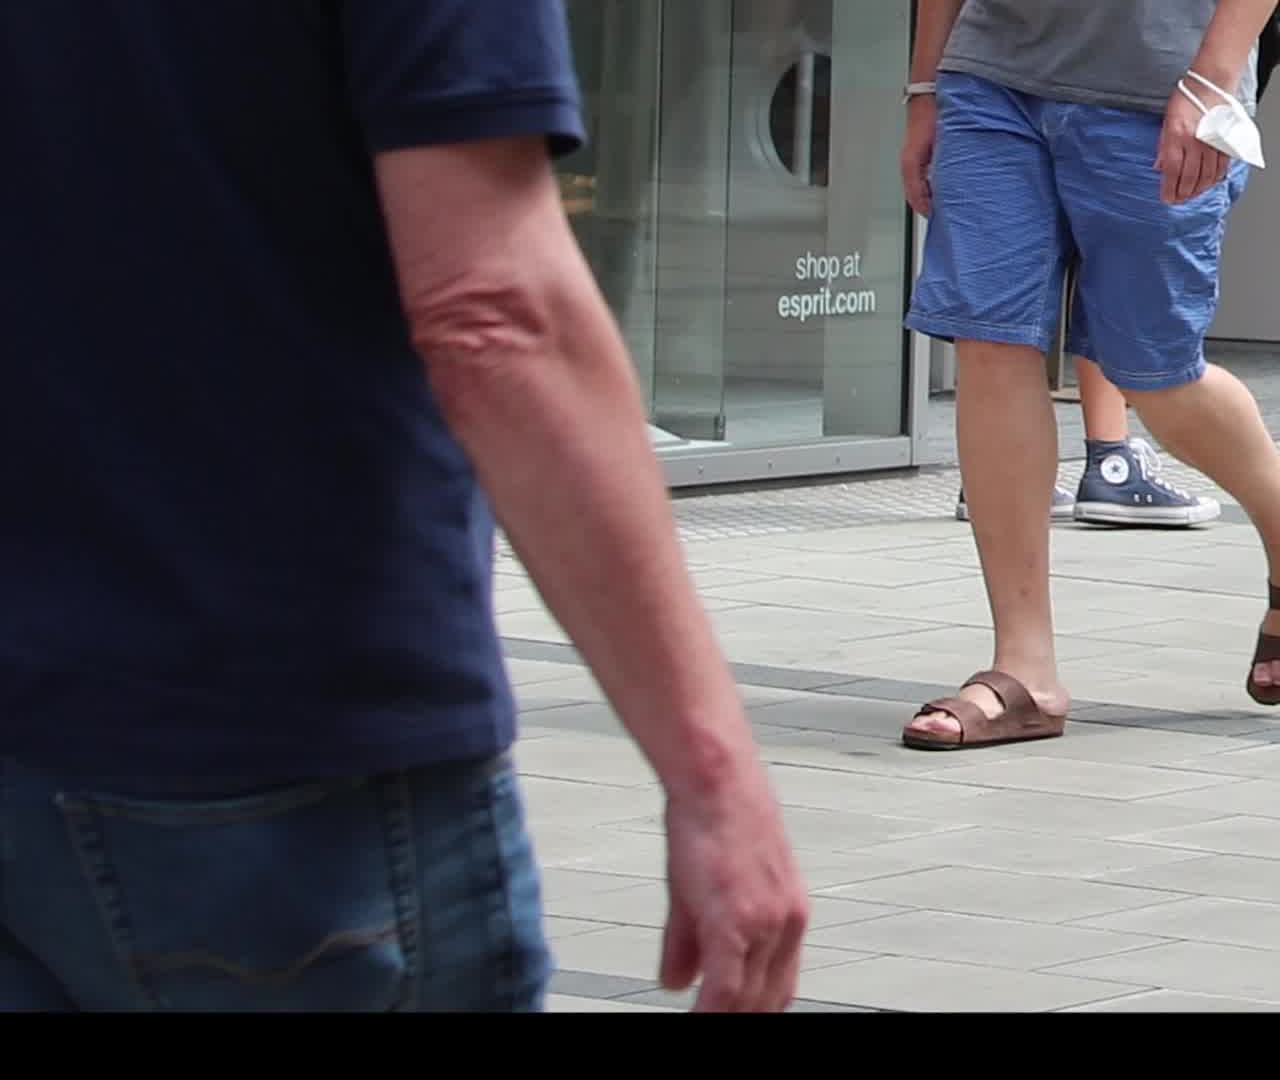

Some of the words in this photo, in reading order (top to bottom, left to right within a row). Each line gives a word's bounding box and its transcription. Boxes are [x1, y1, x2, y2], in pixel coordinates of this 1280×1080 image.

[796, 251, 839, 284] shop
[843, 251, 861, 278] at
[778, 287, 876, 322] esprit.com
